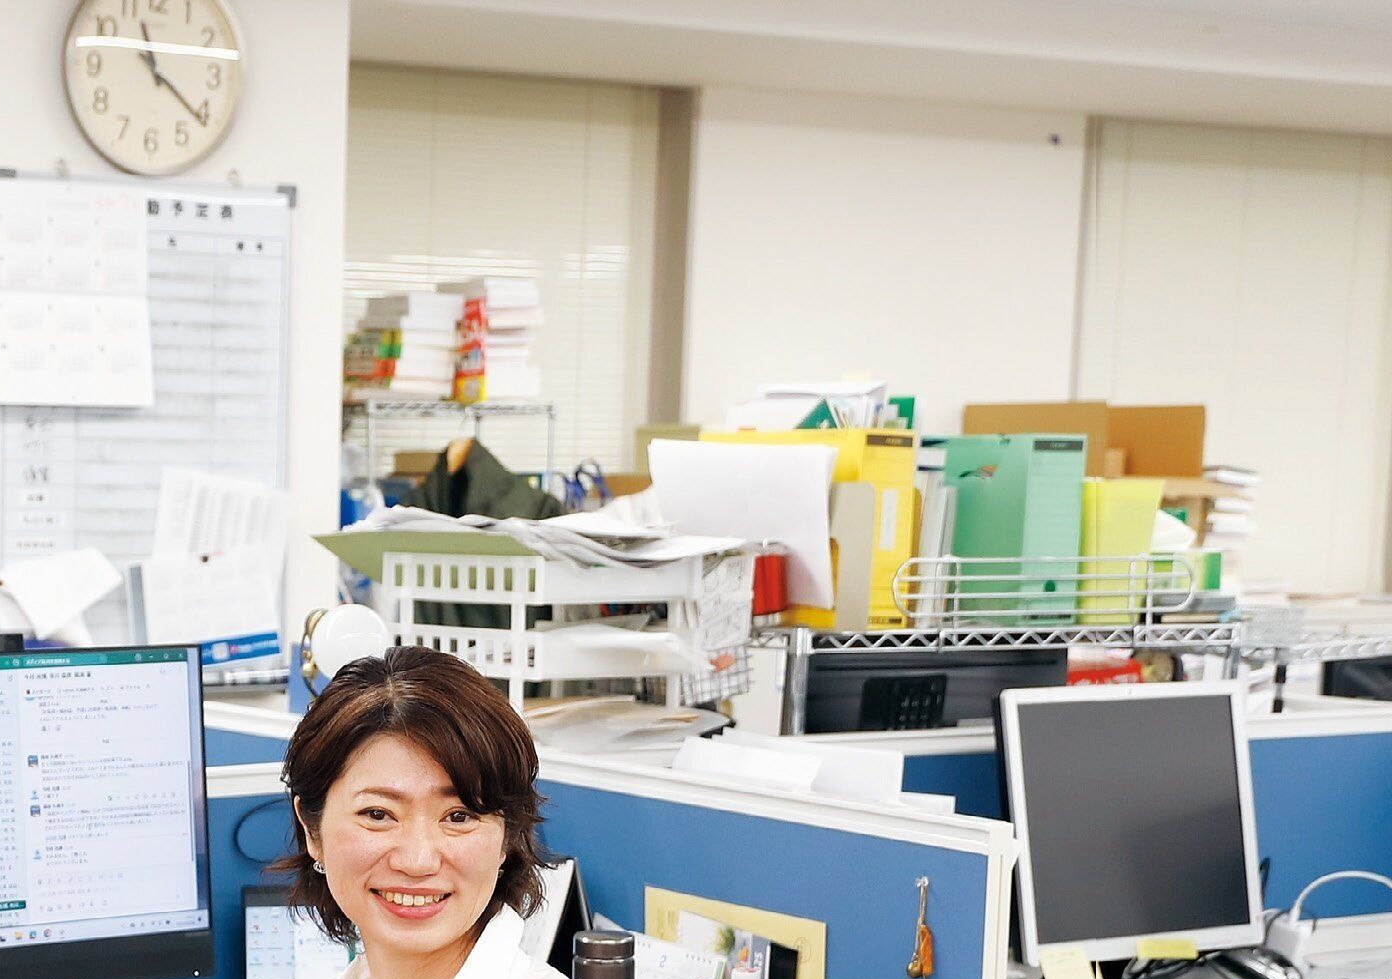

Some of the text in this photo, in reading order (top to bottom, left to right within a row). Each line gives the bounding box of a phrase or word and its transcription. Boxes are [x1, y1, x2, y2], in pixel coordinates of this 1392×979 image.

[86, 50, 102, 79] 9
[206, 62, 221, 90] 3
[92, 86, 109, 115] 8
[195, 98, 210, 128] 4
[116, 113, 131, 140] 7
[142, 126, 159, 154] 6
[174, 120, 190, 147] 5
